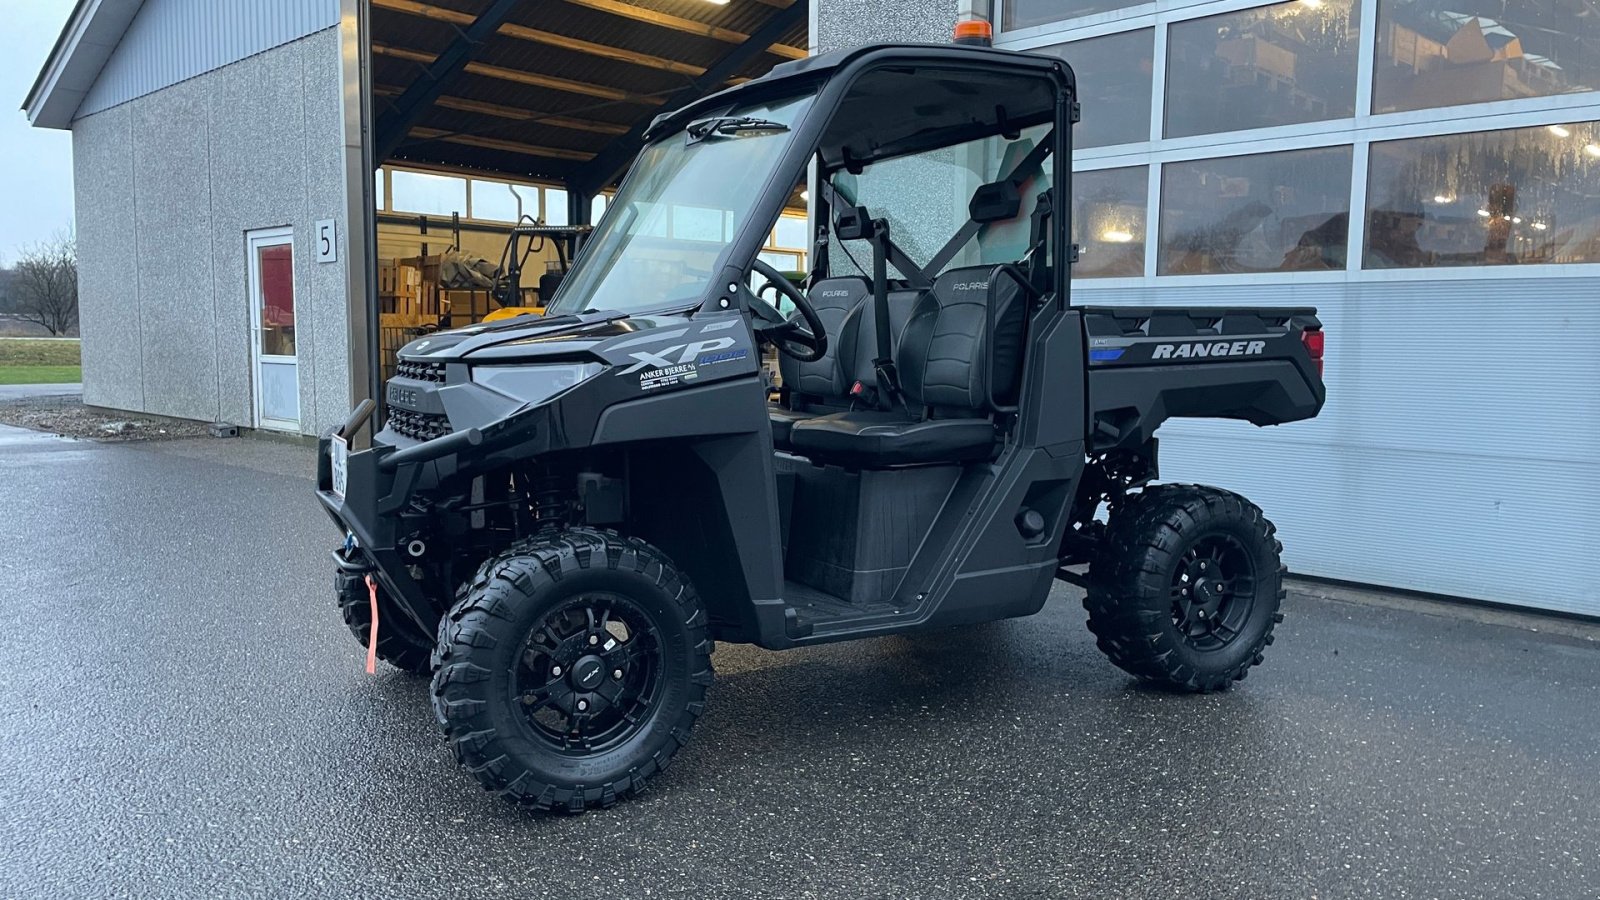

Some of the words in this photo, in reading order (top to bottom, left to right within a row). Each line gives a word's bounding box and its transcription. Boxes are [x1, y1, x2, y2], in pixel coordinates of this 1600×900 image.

[320, 225, 330, 256] 5
[822, 289, 849, 298] POLARIS
[952, 281, 989, 292] POLARIS
[614, 336, 736, 377] XP
[1151, 340, 1266, 360] RANGER
[640, 369, 664, 381] ANKER
[664, 364, 688, 376] BJERRE
